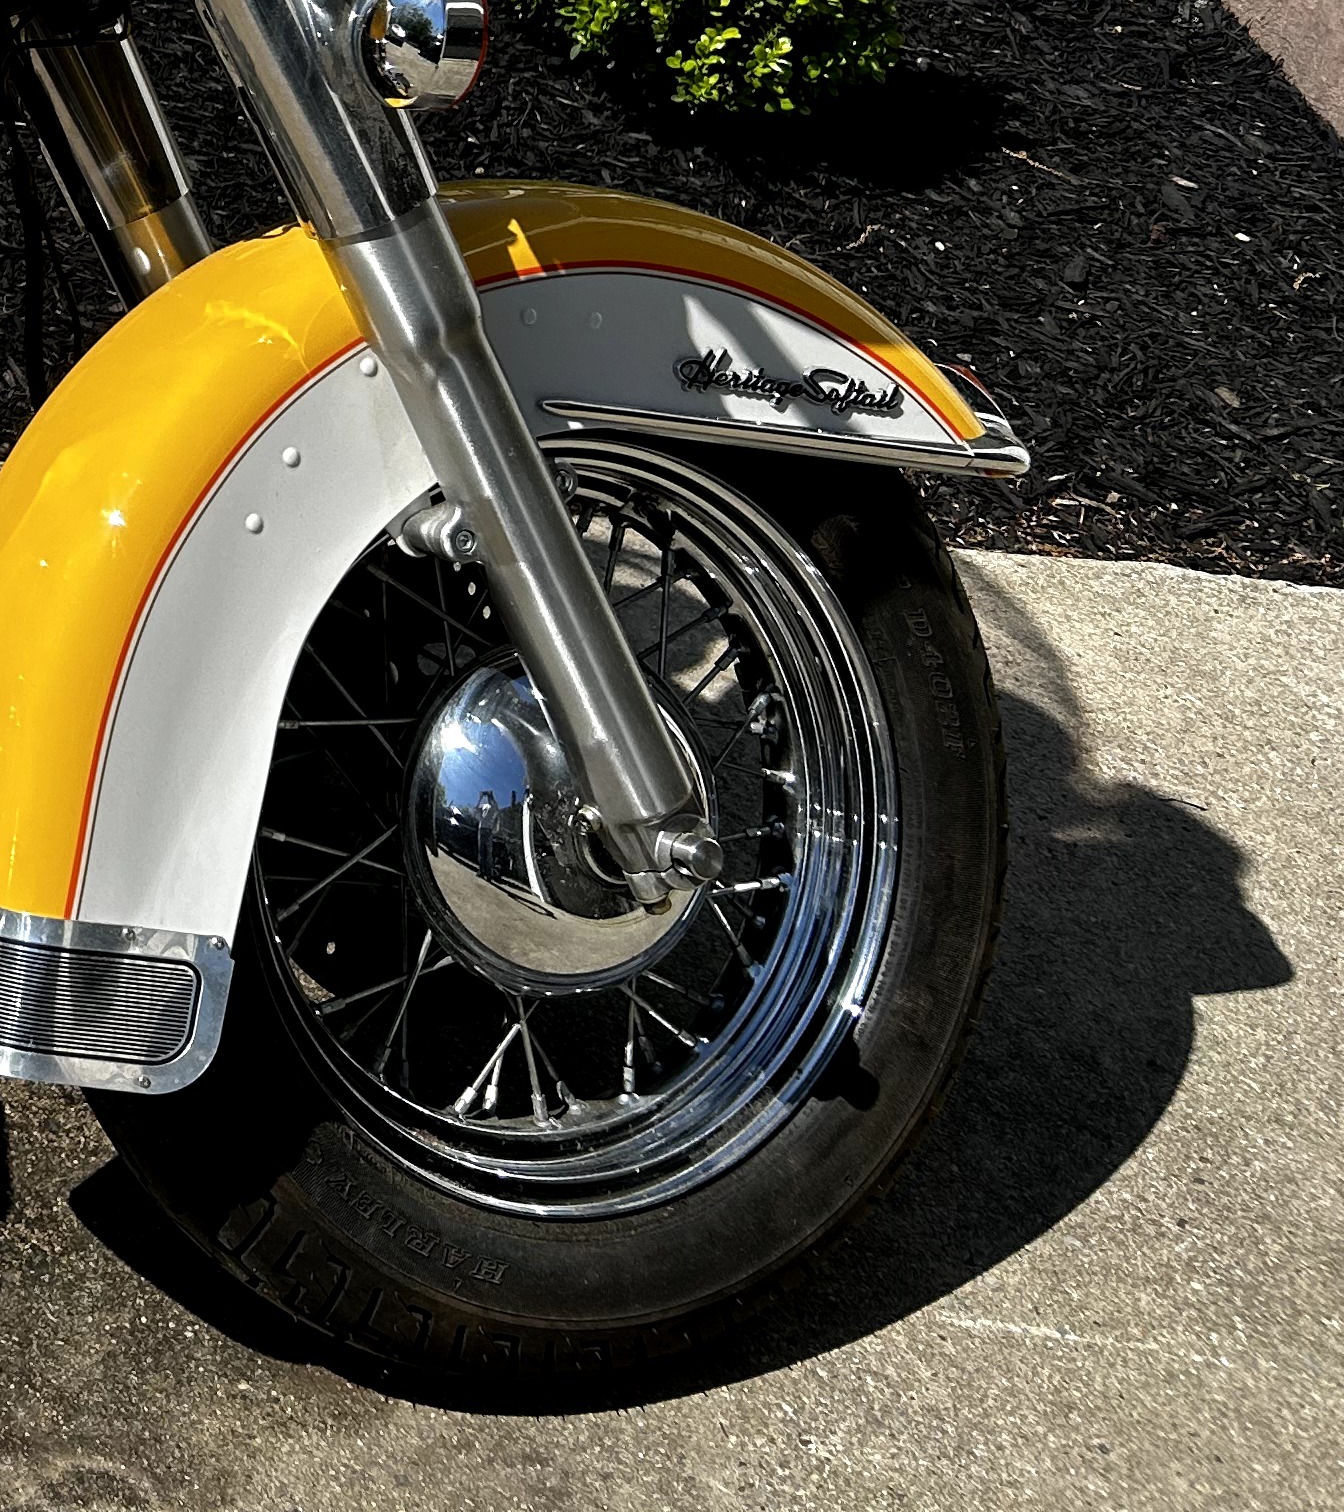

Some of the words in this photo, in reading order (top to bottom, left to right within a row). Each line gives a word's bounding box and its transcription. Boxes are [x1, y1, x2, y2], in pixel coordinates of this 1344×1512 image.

[679, 346, 805, 407] Heritage
[802, 367, 900, 414] Softail
[325, 1172, 510, 1286] HARLEY
